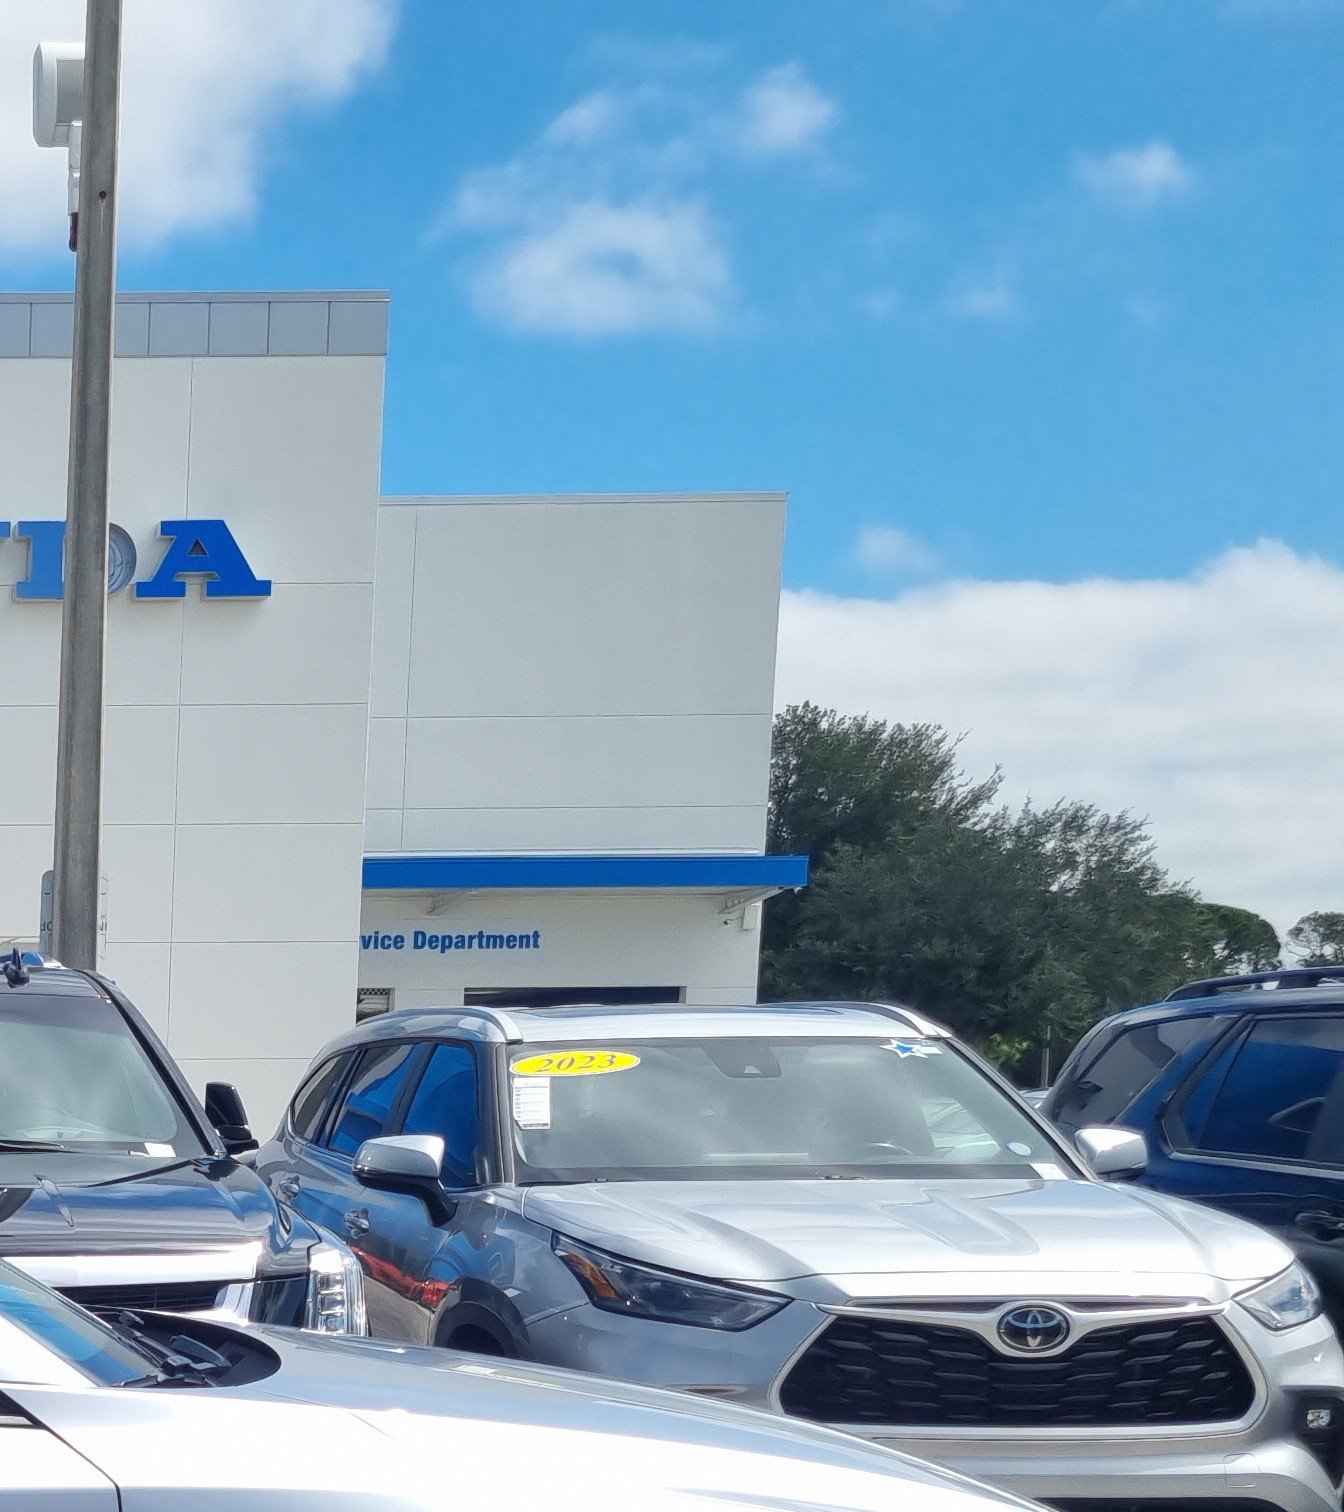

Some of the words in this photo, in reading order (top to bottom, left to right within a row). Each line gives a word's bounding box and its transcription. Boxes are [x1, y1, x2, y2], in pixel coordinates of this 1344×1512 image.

[359, 930, 405, 950] vice
[413, 930, 542, 954] Department
[534, 1054, 618, 1073] 2023
